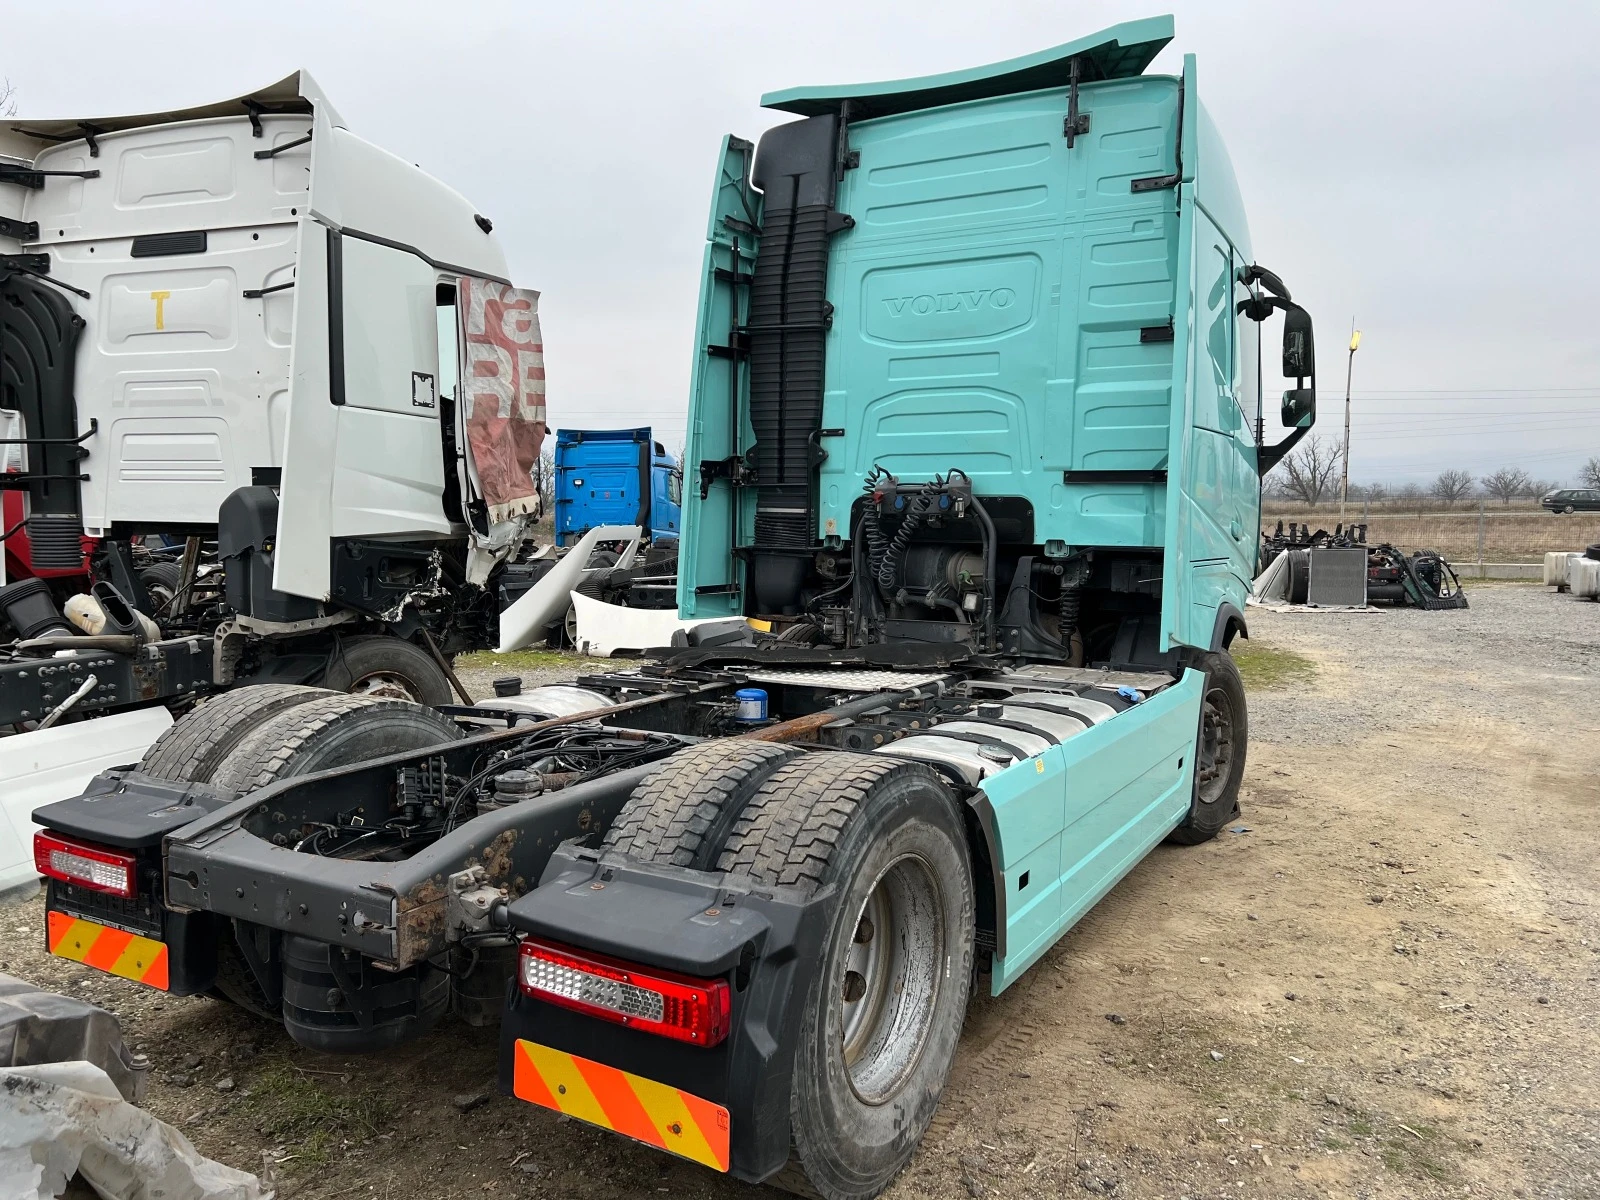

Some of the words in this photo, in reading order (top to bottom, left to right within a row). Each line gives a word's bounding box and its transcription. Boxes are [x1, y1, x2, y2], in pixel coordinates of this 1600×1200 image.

[151, 291, 170, 330] T
[881, 287, 1016, 318] VOLVO
[465, 342, 545, 421] RE
[956, 862, 973, 944] GOLDEN
[952, 949, 970, 1037] CROWN
